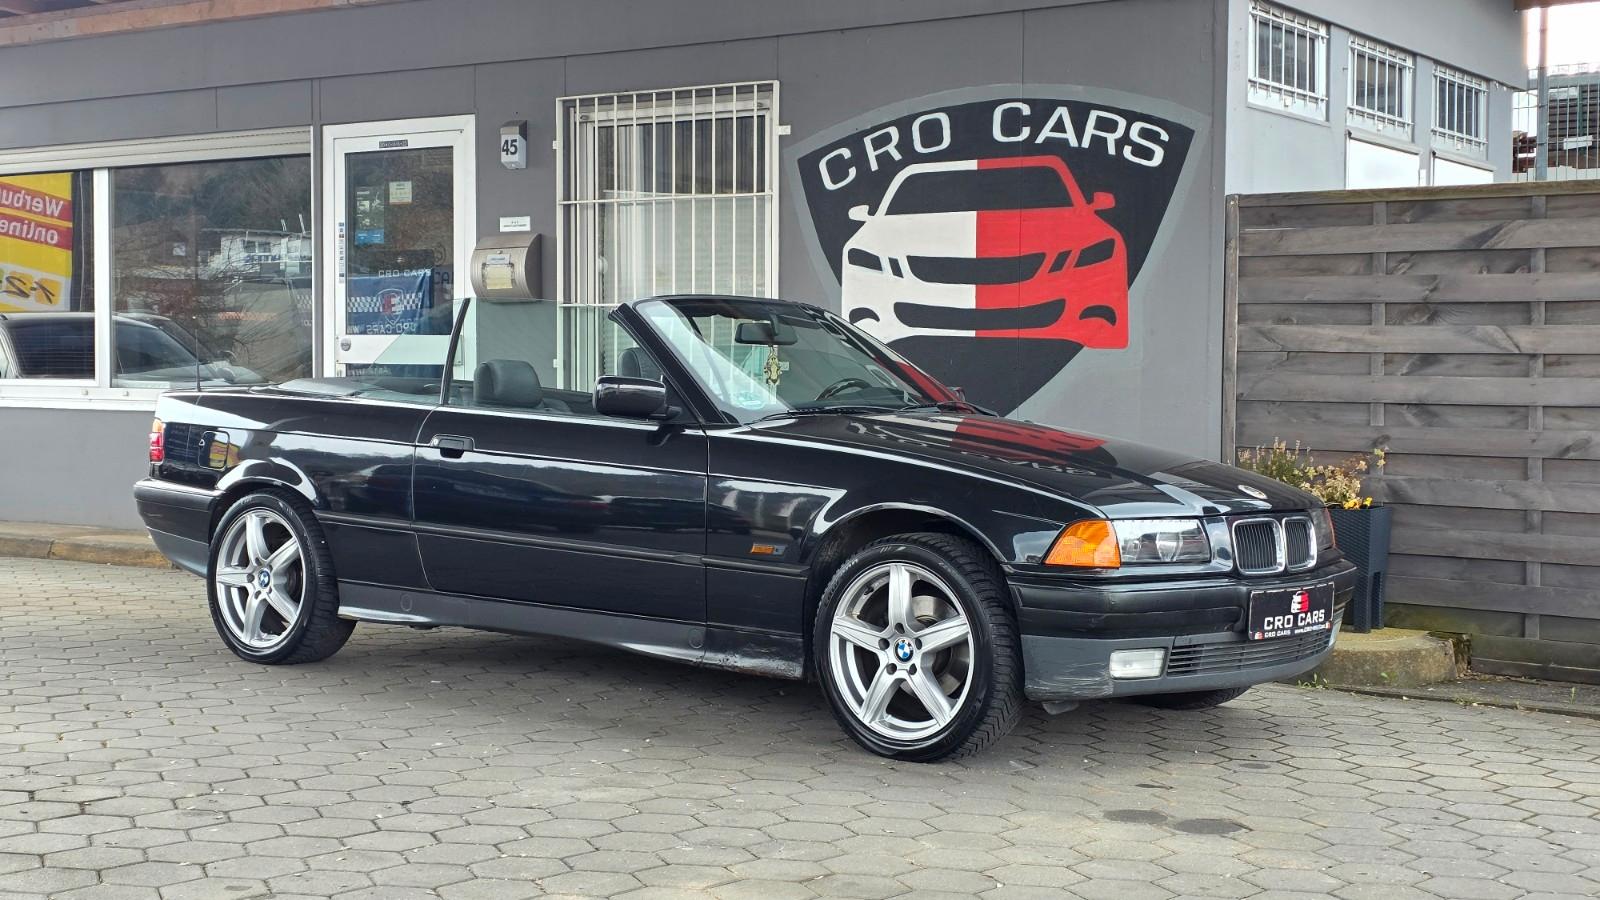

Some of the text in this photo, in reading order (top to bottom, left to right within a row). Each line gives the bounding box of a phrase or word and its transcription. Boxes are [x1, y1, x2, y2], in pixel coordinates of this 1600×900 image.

[502, 138, 518, 155] 45
[818, 101, 1170, 191] CRO CARS
[1264, 614, 1293, 630] CRO
[1298, 609, 1325, 626] CARS
